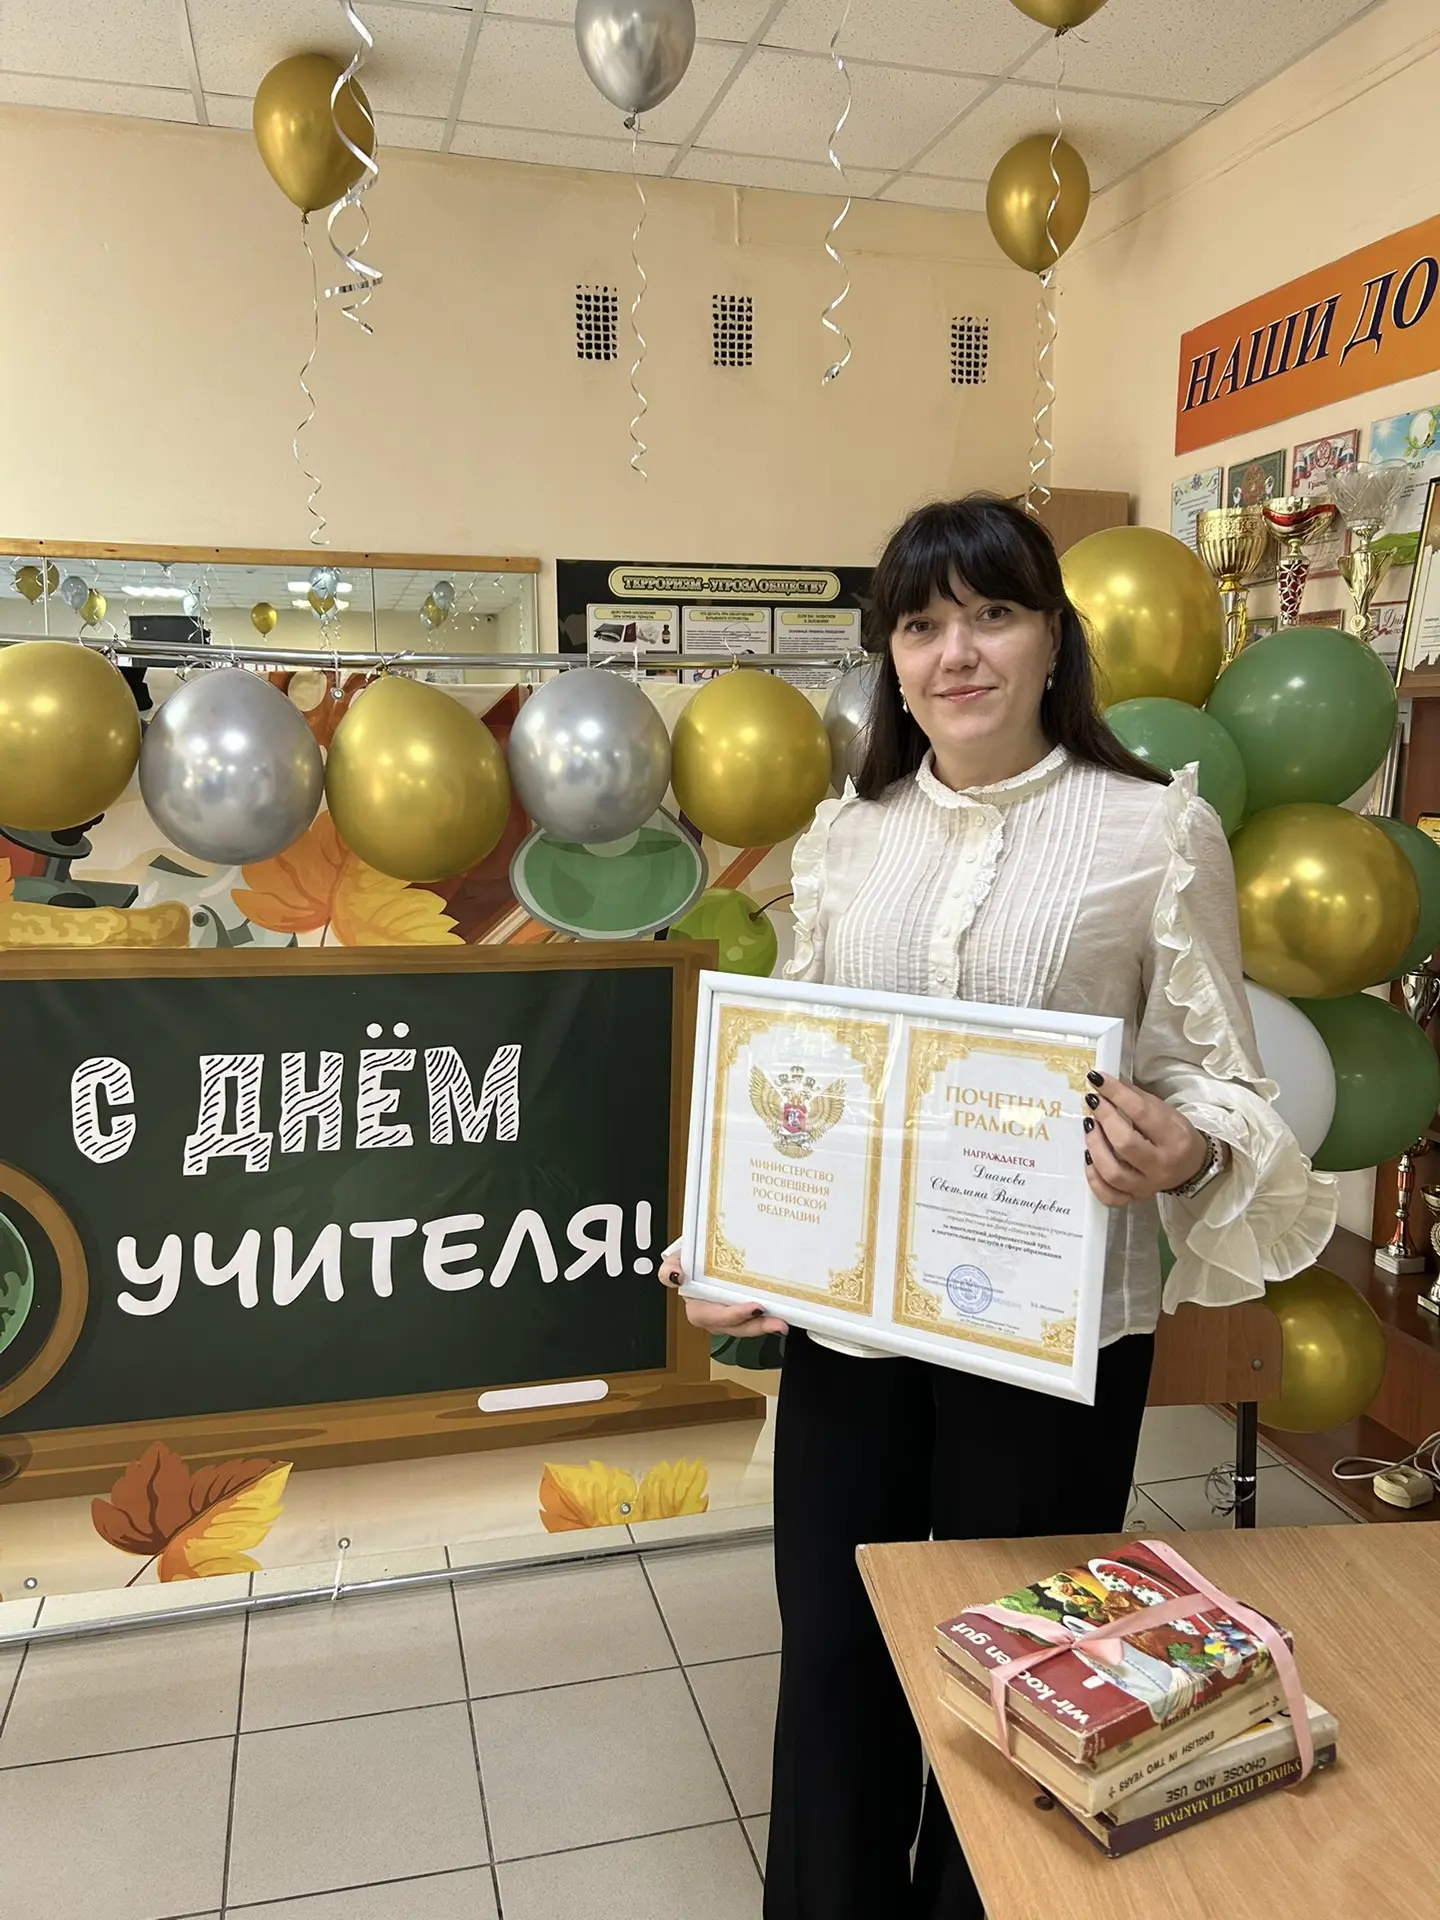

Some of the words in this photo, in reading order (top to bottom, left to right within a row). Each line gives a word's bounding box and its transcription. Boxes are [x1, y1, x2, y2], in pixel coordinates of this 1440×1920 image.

[1181, 293, 1342, 412] НАШИ
[1338, 256, 1439, 367] ДО
[623, 576, 702, 591] ТЕРРОРИЗМ
[709, 578, 759, 593] УГРОЗА
[758, 579, 827, 596] ОБЩЕСТВУ
[70, 1056, 137, 1164] С
[182, 1021, 523, 1176] ДНЁМ
[945, 1085, 1062, 1118] ПОЧЕТНАЯ
[953, 1109, 1050, 1141] ГРАМОТА
[749, 1158, 834, 1183] МИНИСТЕРСТВО
[963, 1148, 1036, 1168] НАГРАЖДАЕТСЯ
[751, 1172, 830, 1197] ПРОСВЕЩЕНИЯ
[973, 1163, 1026, 1187] Дианова
[752, 1187, 827, 1211] РОССИЙСКОЙ
[930, 1175, 988, 1200] Светлана
[991, 1187, 1071, 1215] Викторовна
[757, 1202, 820, 1224] ФЕДЕРАЦИИ
[117, 1200, 656, 1316] УЧИТЕЛЯ!
[950, 1622, 992, 1645] gut
[985, 1645, 1057, 1701] kocen
[1051, 1698, 1090, 1725] wir
[1181, 1729, 1216, 1756] ENGLISH
[1146, 1756, 1166, 1775] TWO
[1168, 1751, 1179, 1763] IN
[1223, 1756, 1267, 1782] CHOOSE
[1119, 1772, 1145, 1793] YEARS
[1194, 1774, 1217, 1791] AND
[1257, 1757, 1301, 1786] УЧИМСЯ
[1166, 1787, 1188, 1803] USE
[1212, 1779, 1255, 1808] ПЛЕСТИ
[1153, 1797, 1210, 1831] МАКРАМЕ
